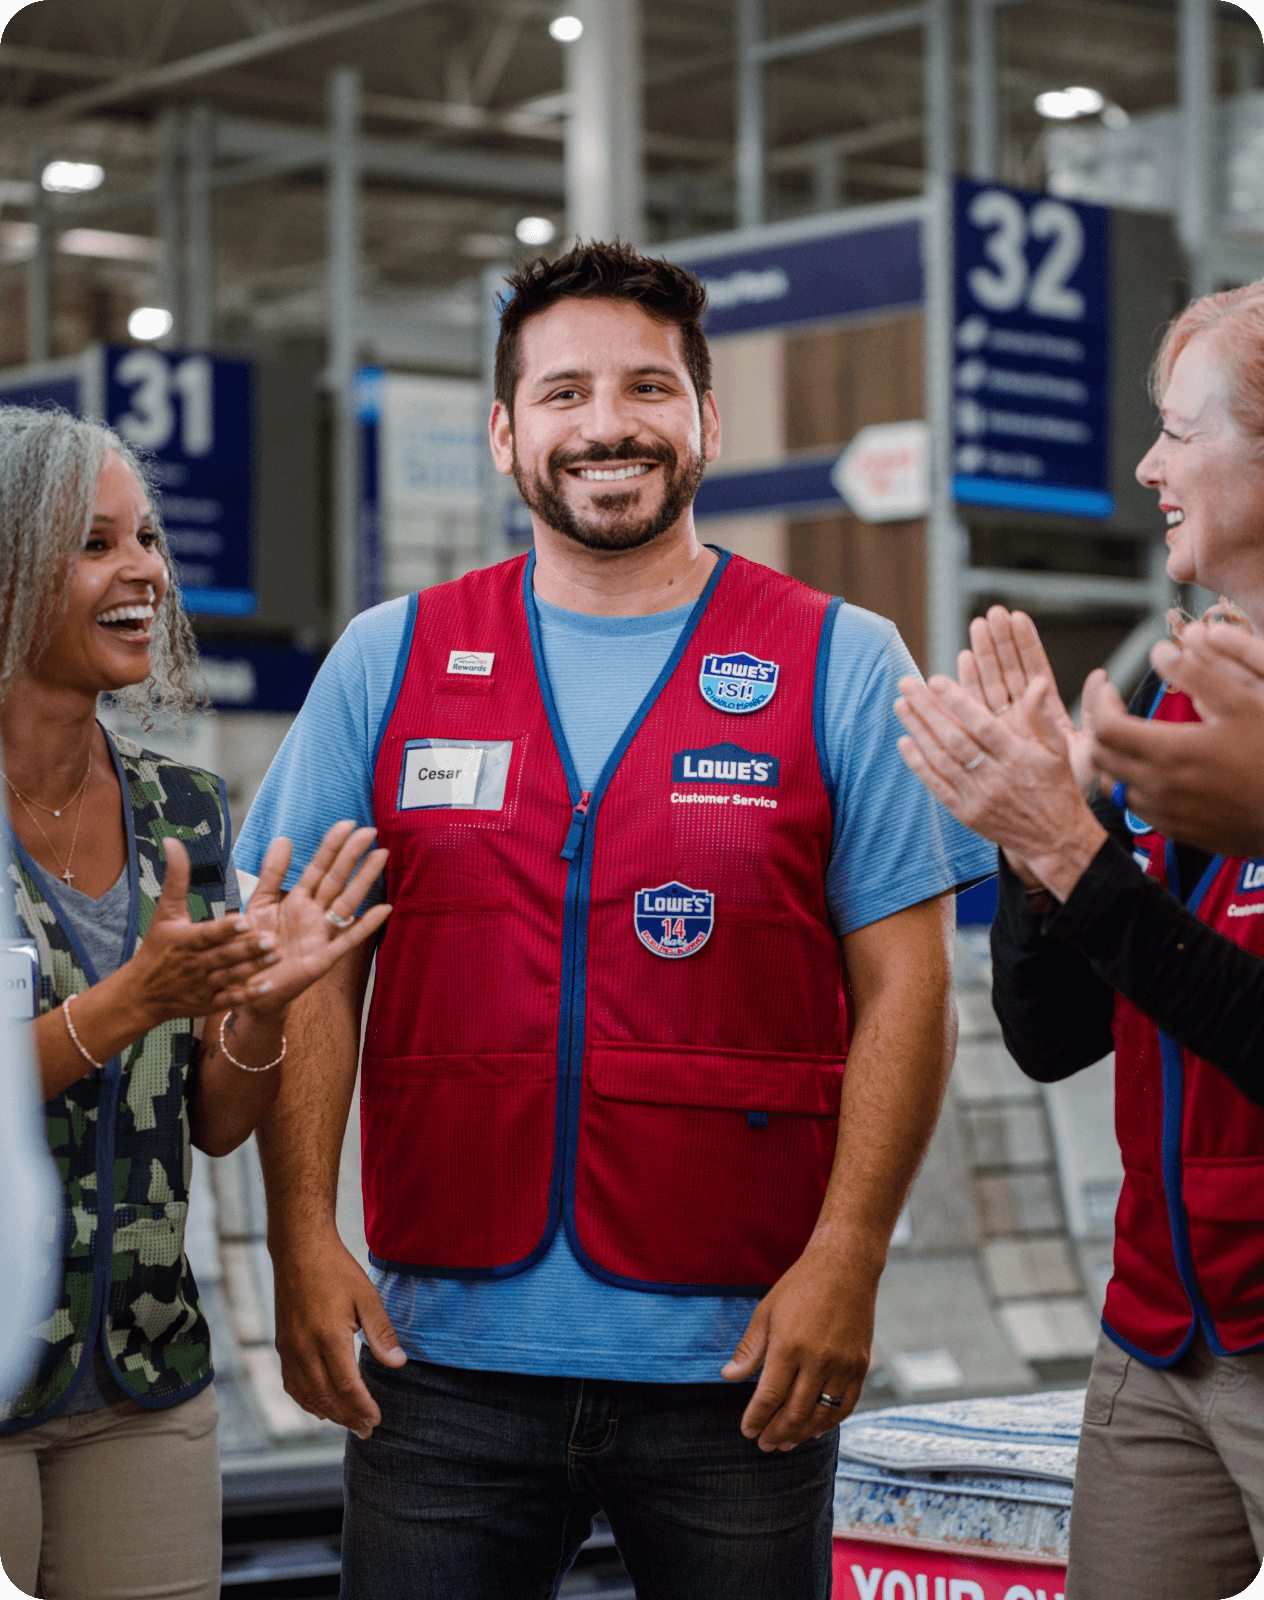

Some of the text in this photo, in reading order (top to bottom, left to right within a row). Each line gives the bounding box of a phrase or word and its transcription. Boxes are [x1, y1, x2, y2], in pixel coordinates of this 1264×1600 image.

[968, 192, 1086, 321] 32
[115, 350, 214, 456] 31
[452, 663, 487, 672] Rewards
[710, 657, 769, 680] LOWE'S
[418, 767, 462, 781] Cesar
[683, 755, 769, 782] LOWE'S
[670, 792, 778, 809] Customer Service
[643, 893, 705, 913] LOWE'S
[661, 917, 686, 939] 14
